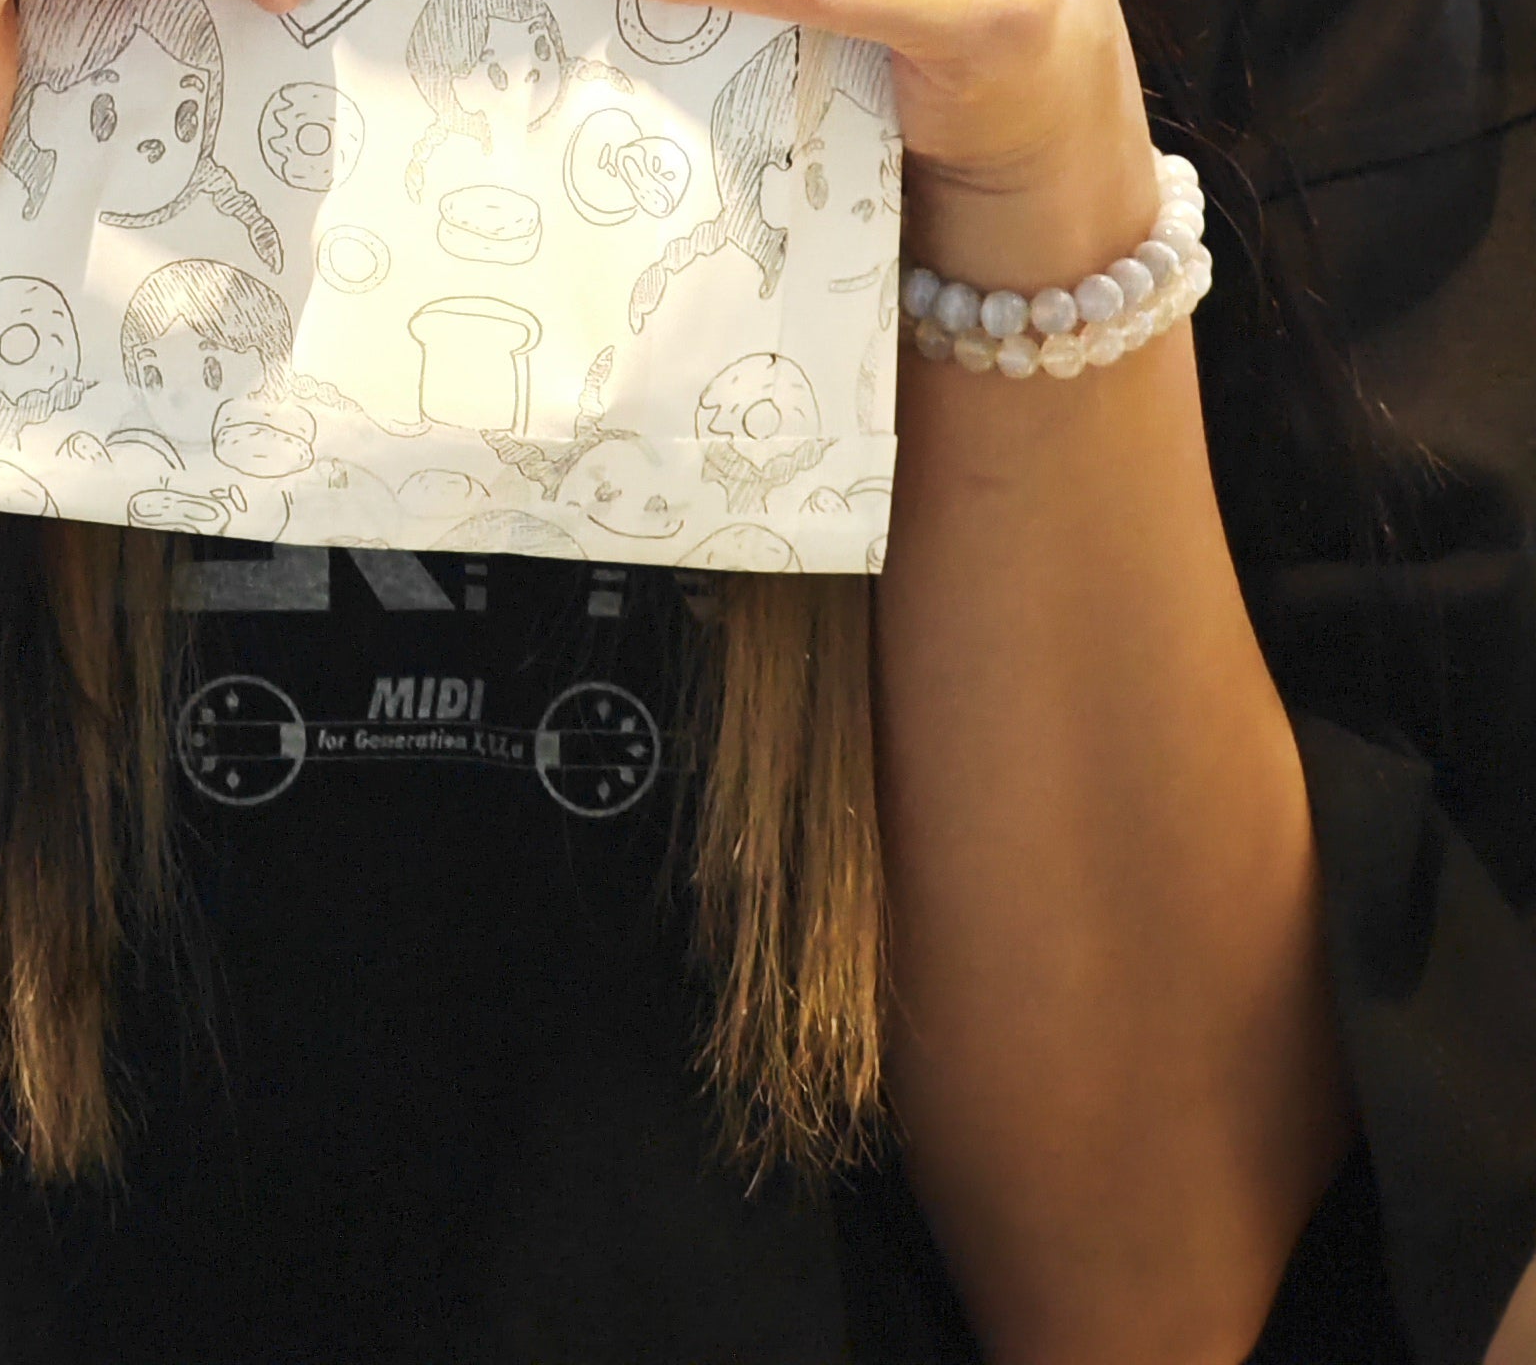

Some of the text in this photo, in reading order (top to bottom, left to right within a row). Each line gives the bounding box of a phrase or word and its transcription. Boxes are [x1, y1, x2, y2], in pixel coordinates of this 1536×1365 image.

[368, 677, 485, 720] MIDI
[318, 729, 347, 750] for
[354, 728, 467, 750] Generation
